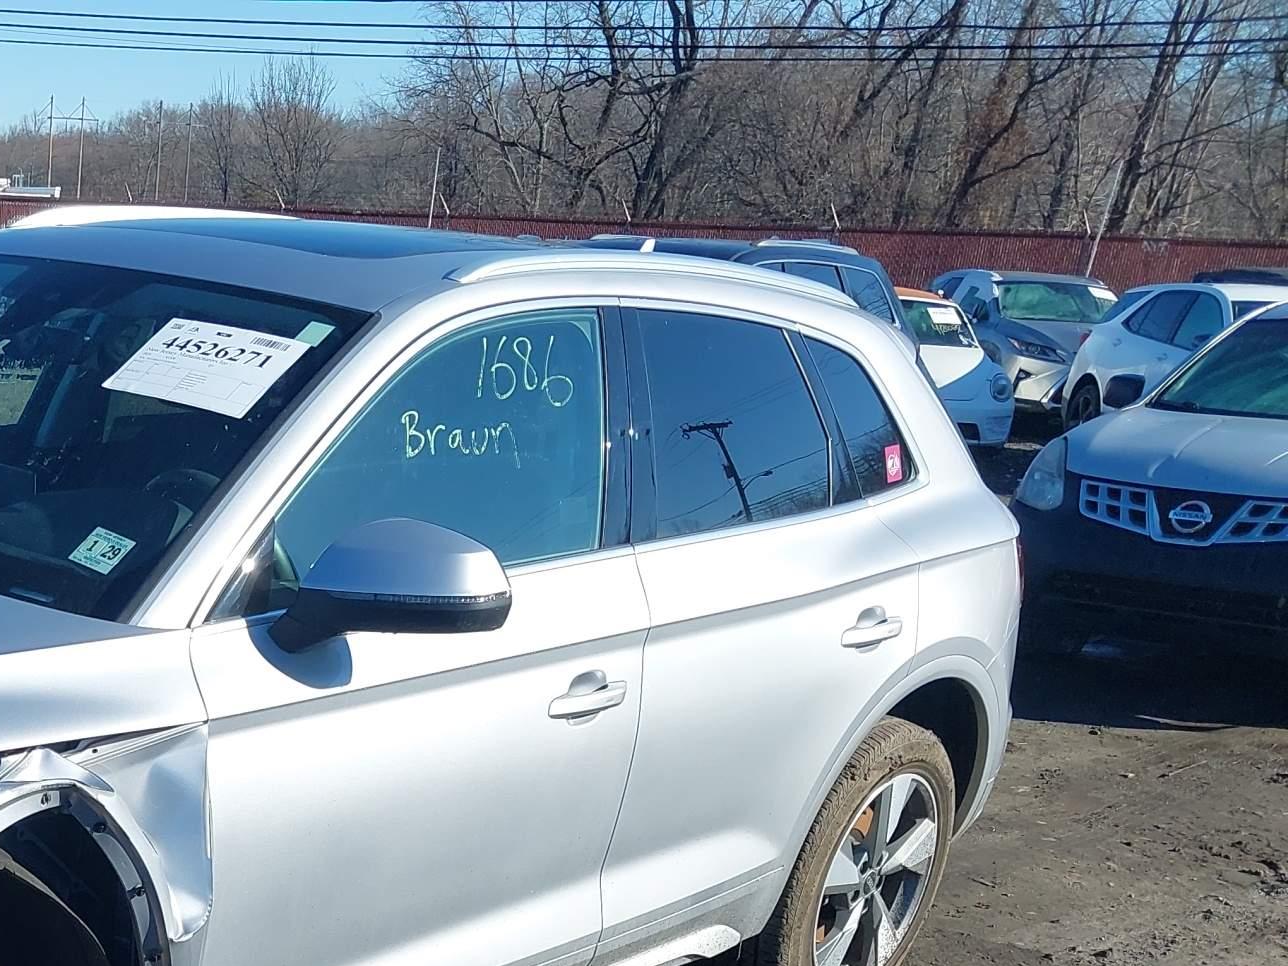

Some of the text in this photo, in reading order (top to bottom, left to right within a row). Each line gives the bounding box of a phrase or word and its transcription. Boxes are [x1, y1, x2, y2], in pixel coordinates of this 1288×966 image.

[162, 335, 273, 369] 44526271
[477, 335, 574, 407] 1686
[1172, 511, 1209, 521] NISSAN
[86, 540, 99, 551] 1
[100, 545, 122, 560] 29
